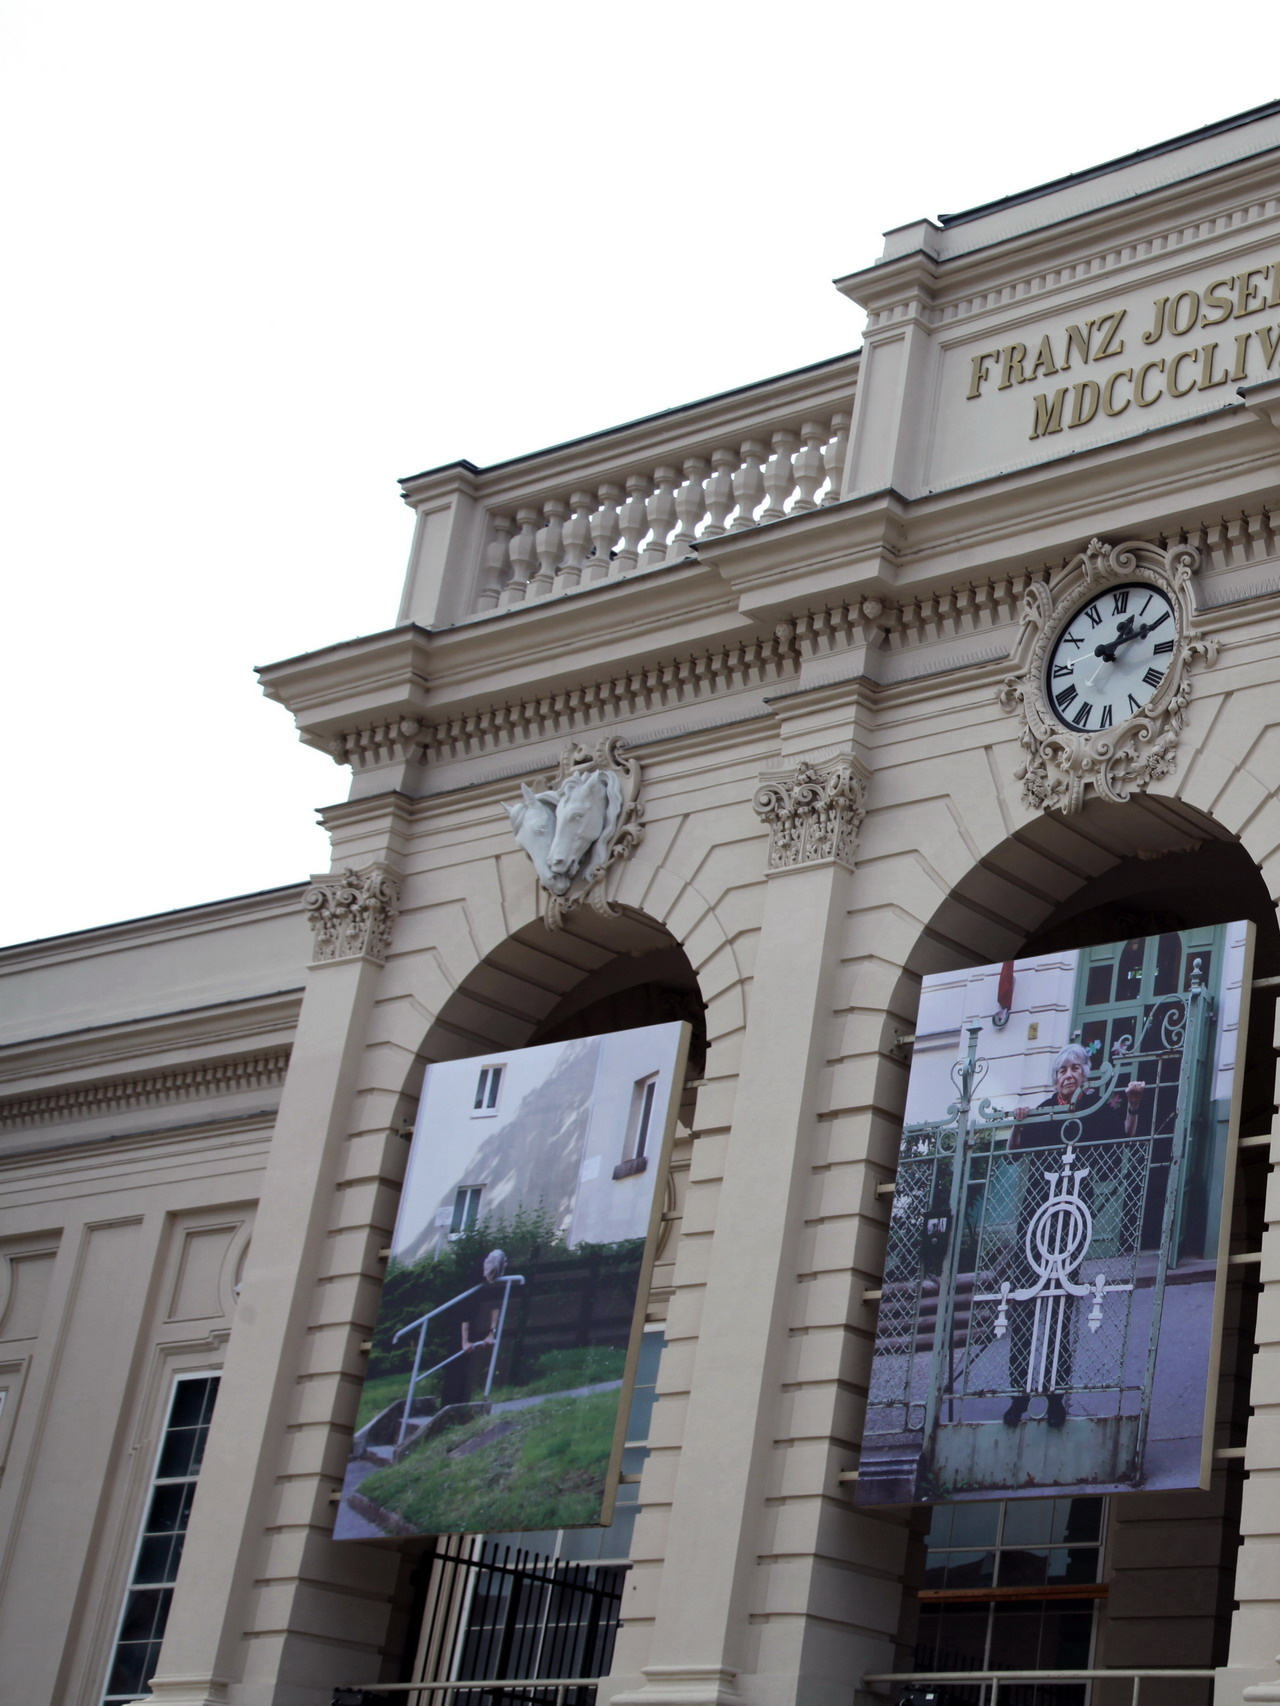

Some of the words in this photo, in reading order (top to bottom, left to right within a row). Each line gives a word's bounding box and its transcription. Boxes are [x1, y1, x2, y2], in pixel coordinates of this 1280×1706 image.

[966, 308, 1127, 400] FRANZ
[1112, 591, 1130, 617] XII
[1138, 594, 1153, 617] I
[1084, 603, 1103, 630] XI
[1063, 631, 1085, 650] X
[1153, 639, 1175, 656] III
[1053, 662, 1075, 679] IX
[1072, 701, 1094, 728] VII
[1127, 693, 1142, 715] V
[1099, 704, 1113, 729] VI
